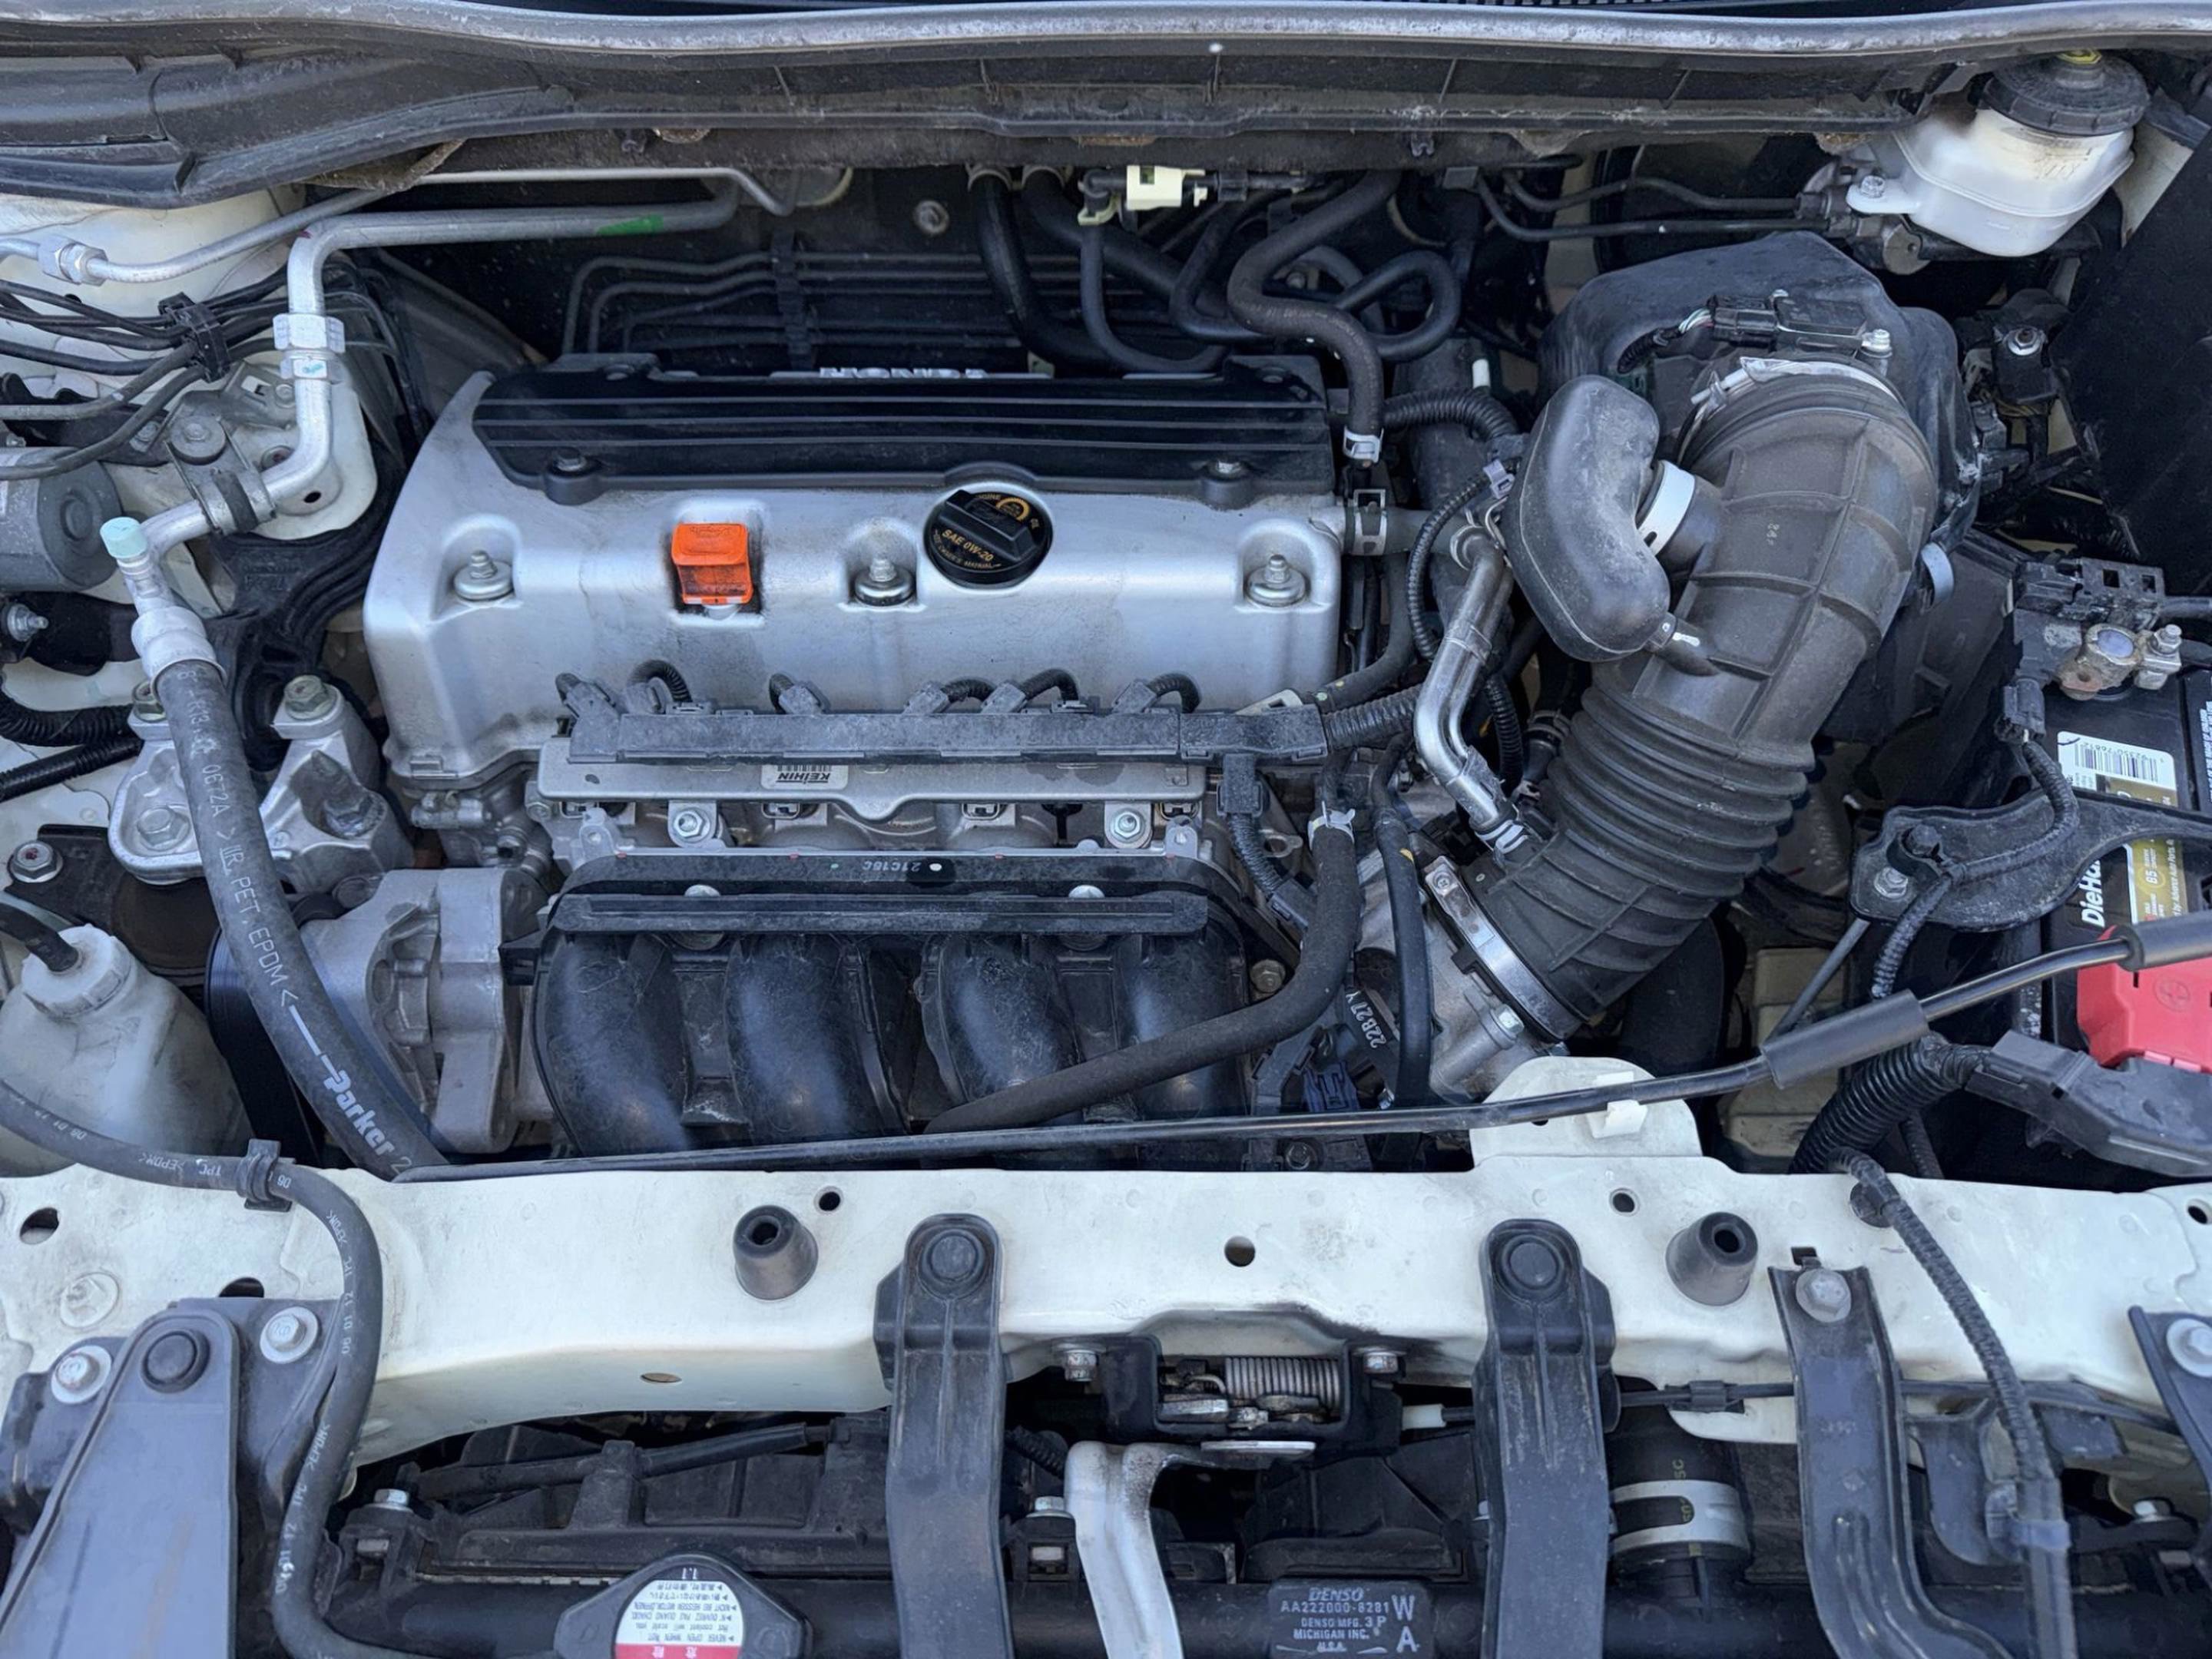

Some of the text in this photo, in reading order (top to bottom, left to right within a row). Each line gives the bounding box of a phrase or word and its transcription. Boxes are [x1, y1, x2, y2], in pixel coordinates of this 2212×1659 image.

[942, 529, 995, 562] SAE 0W-20
[776, 772, 831, 784] KEIHIN
[323, 1069, 396, 1156] Parker
[197, 1164, 223, 1177] TPC
[681, 1568, 697, 1580] 1.1
[1308, 1586, 1365, 1602] DENSO
[1391, 1594, 1416, 1621] W
[1301, 1617, 1335, 1628] DENSO
[1337, 1617, 1363, 1628] MFG.
[1293, 1628, 1370, 1640] MICHIGAN INC.
[1396, 1625, 1418, 1653] A
